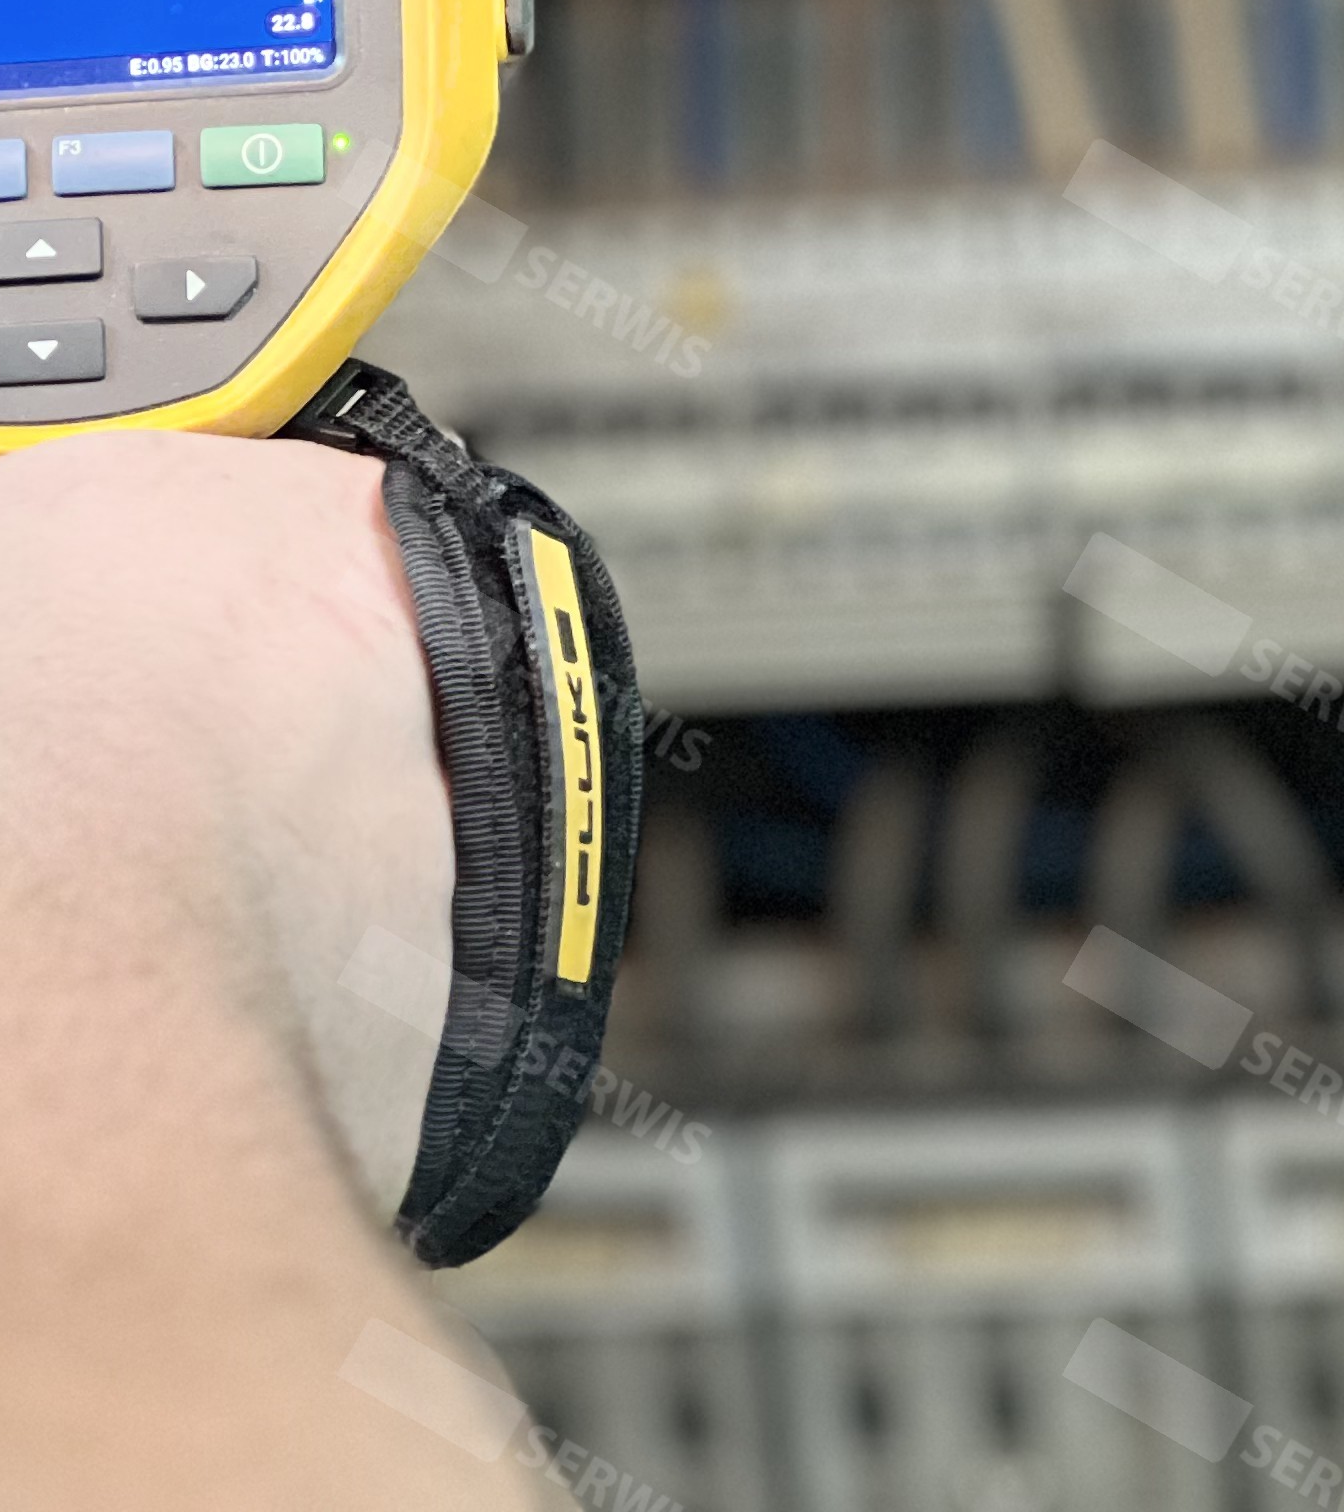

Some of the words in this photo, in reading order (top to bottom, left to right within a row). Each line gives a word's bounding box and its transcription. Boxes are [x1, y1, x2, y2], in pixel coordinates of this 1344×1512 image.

[271, 12, 315, 33] 22.8
[129, 56, 182, 76] E:0.95
[187, 51, 254, 73] BG:23.0
[260, 47, 324, 67] T:100%
[58, 139, 82, 156] F3
[553, 607, 594, 906] FLUKE
